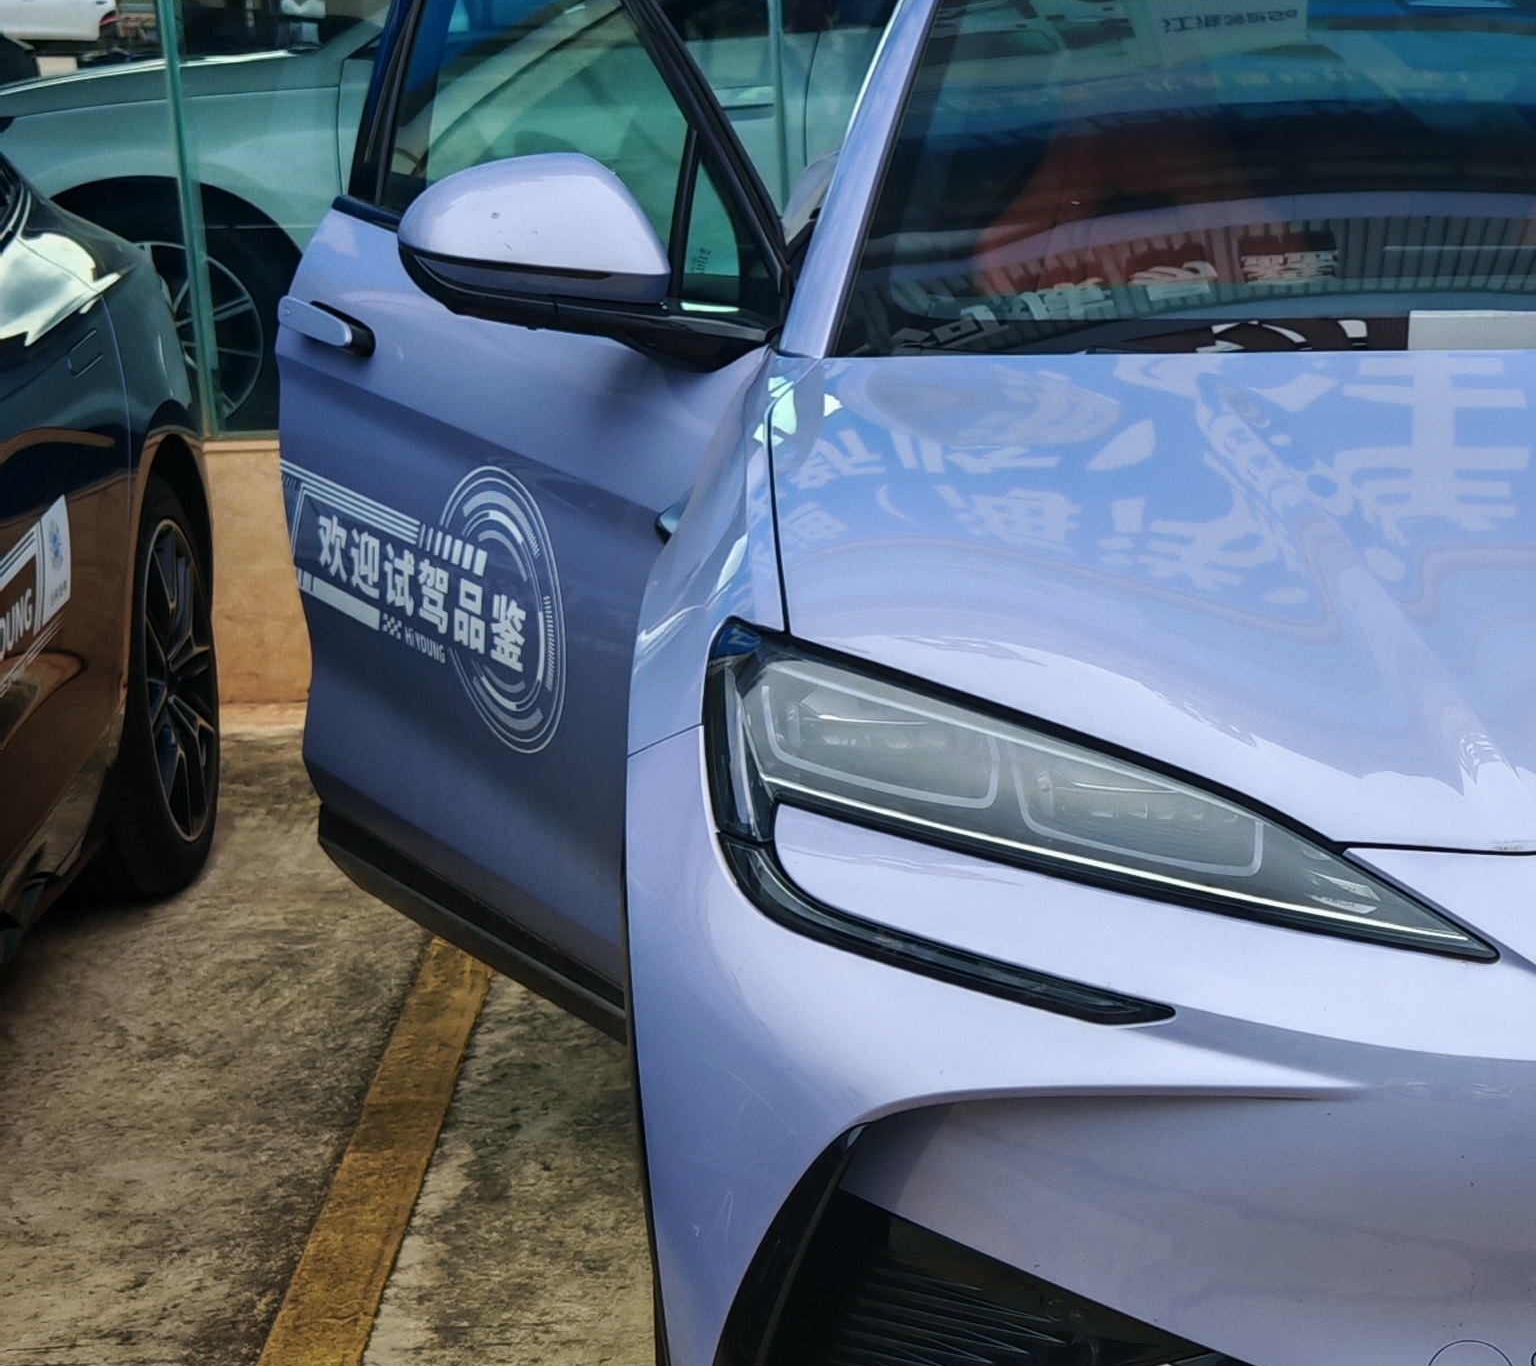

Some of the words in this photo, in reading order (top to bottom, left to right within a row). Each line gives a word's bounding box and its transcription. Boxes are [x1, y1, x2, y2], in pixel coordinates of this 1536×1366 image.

[316, 513, 527, 673] 欢迎试驾品鉴
